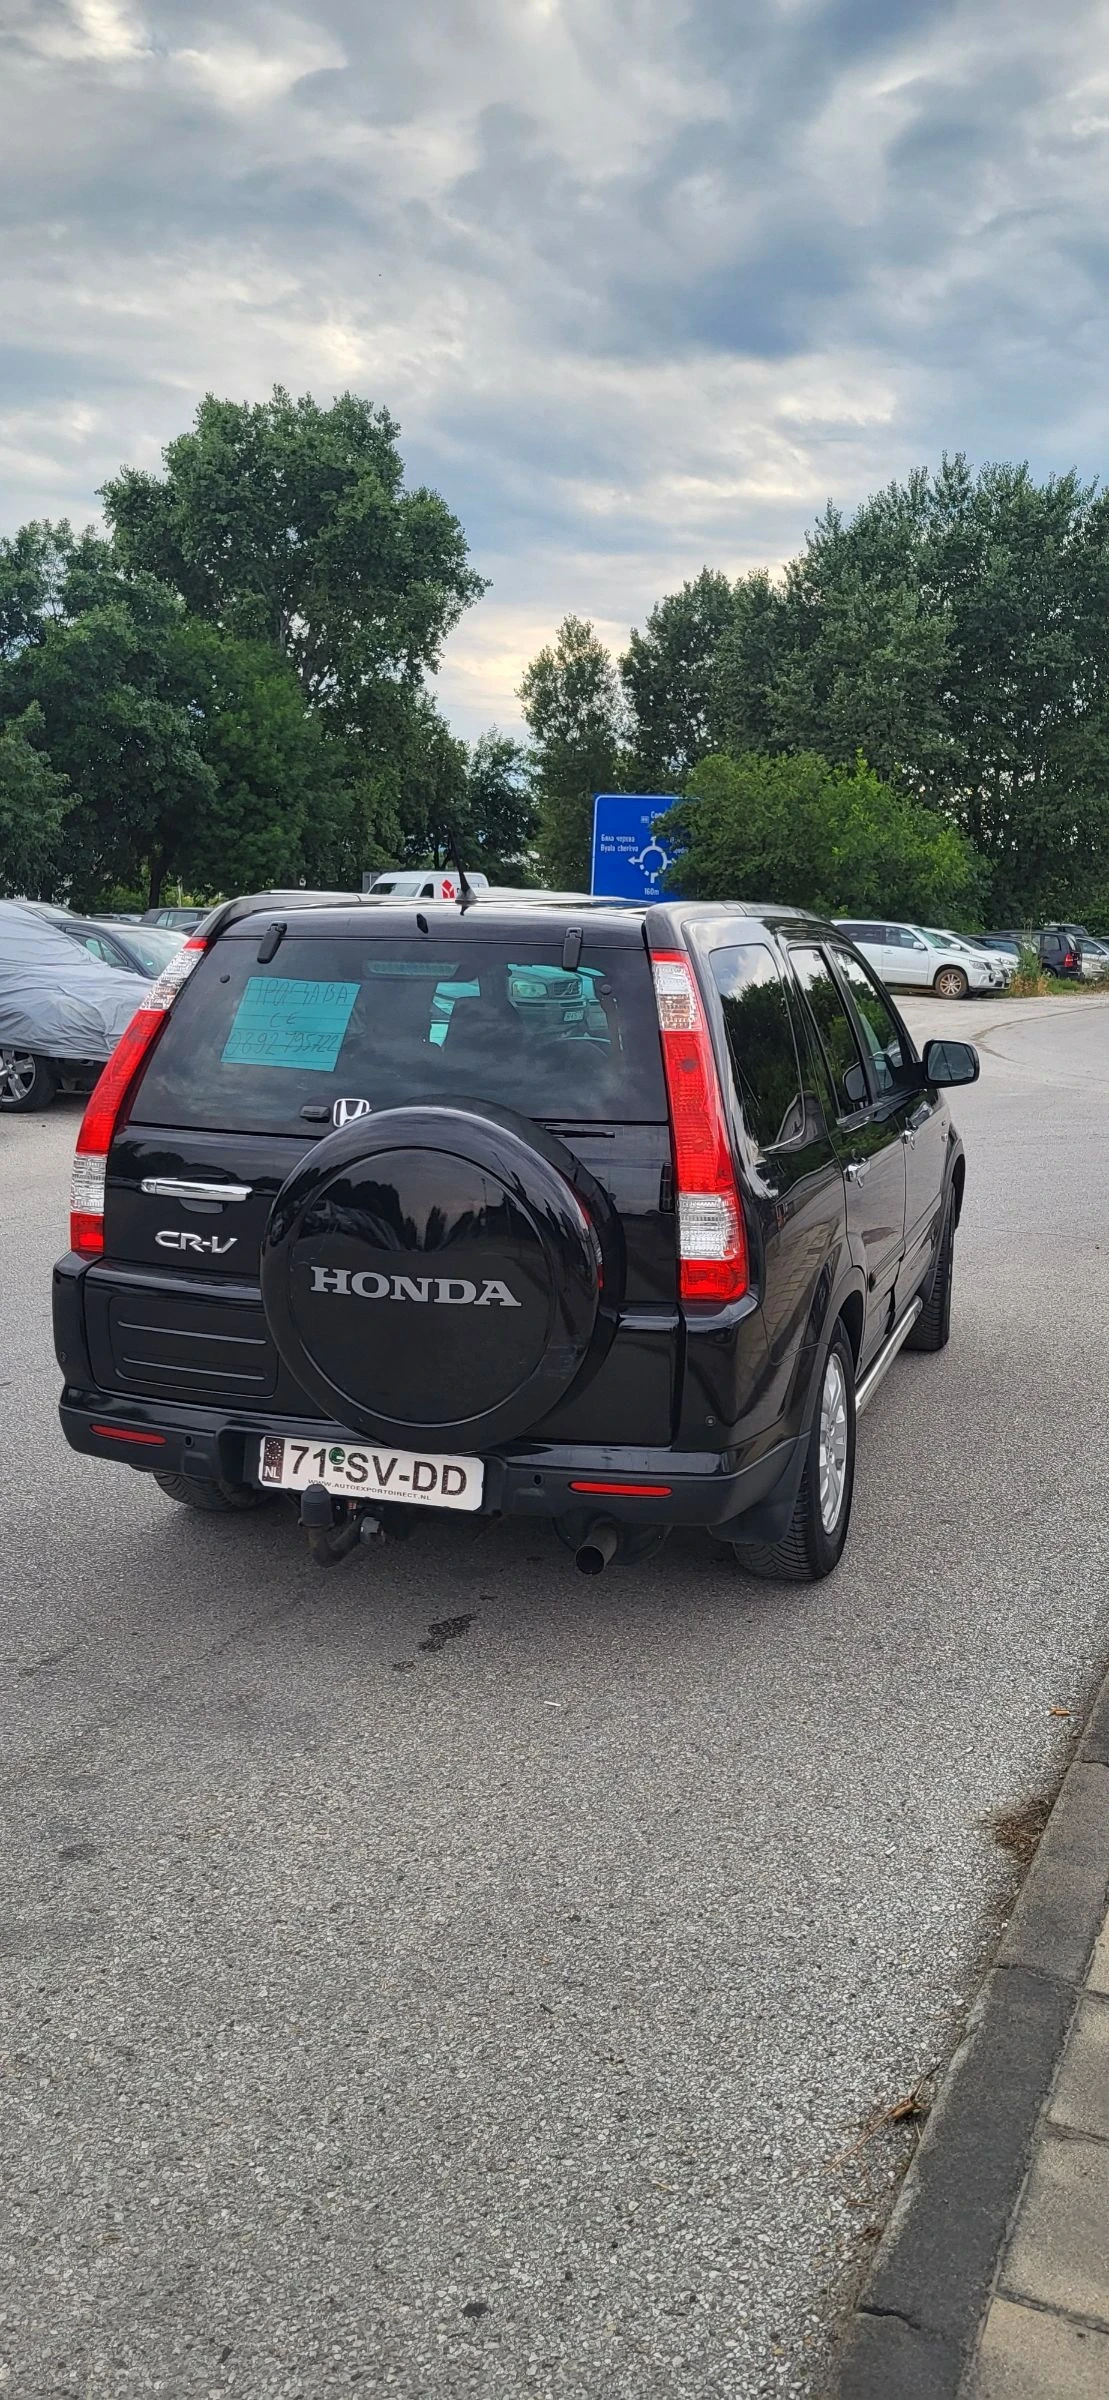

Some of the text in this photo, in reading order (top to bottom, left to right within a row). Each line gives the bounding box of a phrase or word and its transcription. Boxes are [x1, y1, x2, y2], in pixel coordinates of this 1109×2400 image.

[601, 844, 615, 853] Byala
[155, 1230, 239, 1254] CR-V
[310, 1266, 522, 1307] HONDA
[264, 1465, 280, 1479] NL
[289, 1445, 467, 1496] 71-SV-DD
